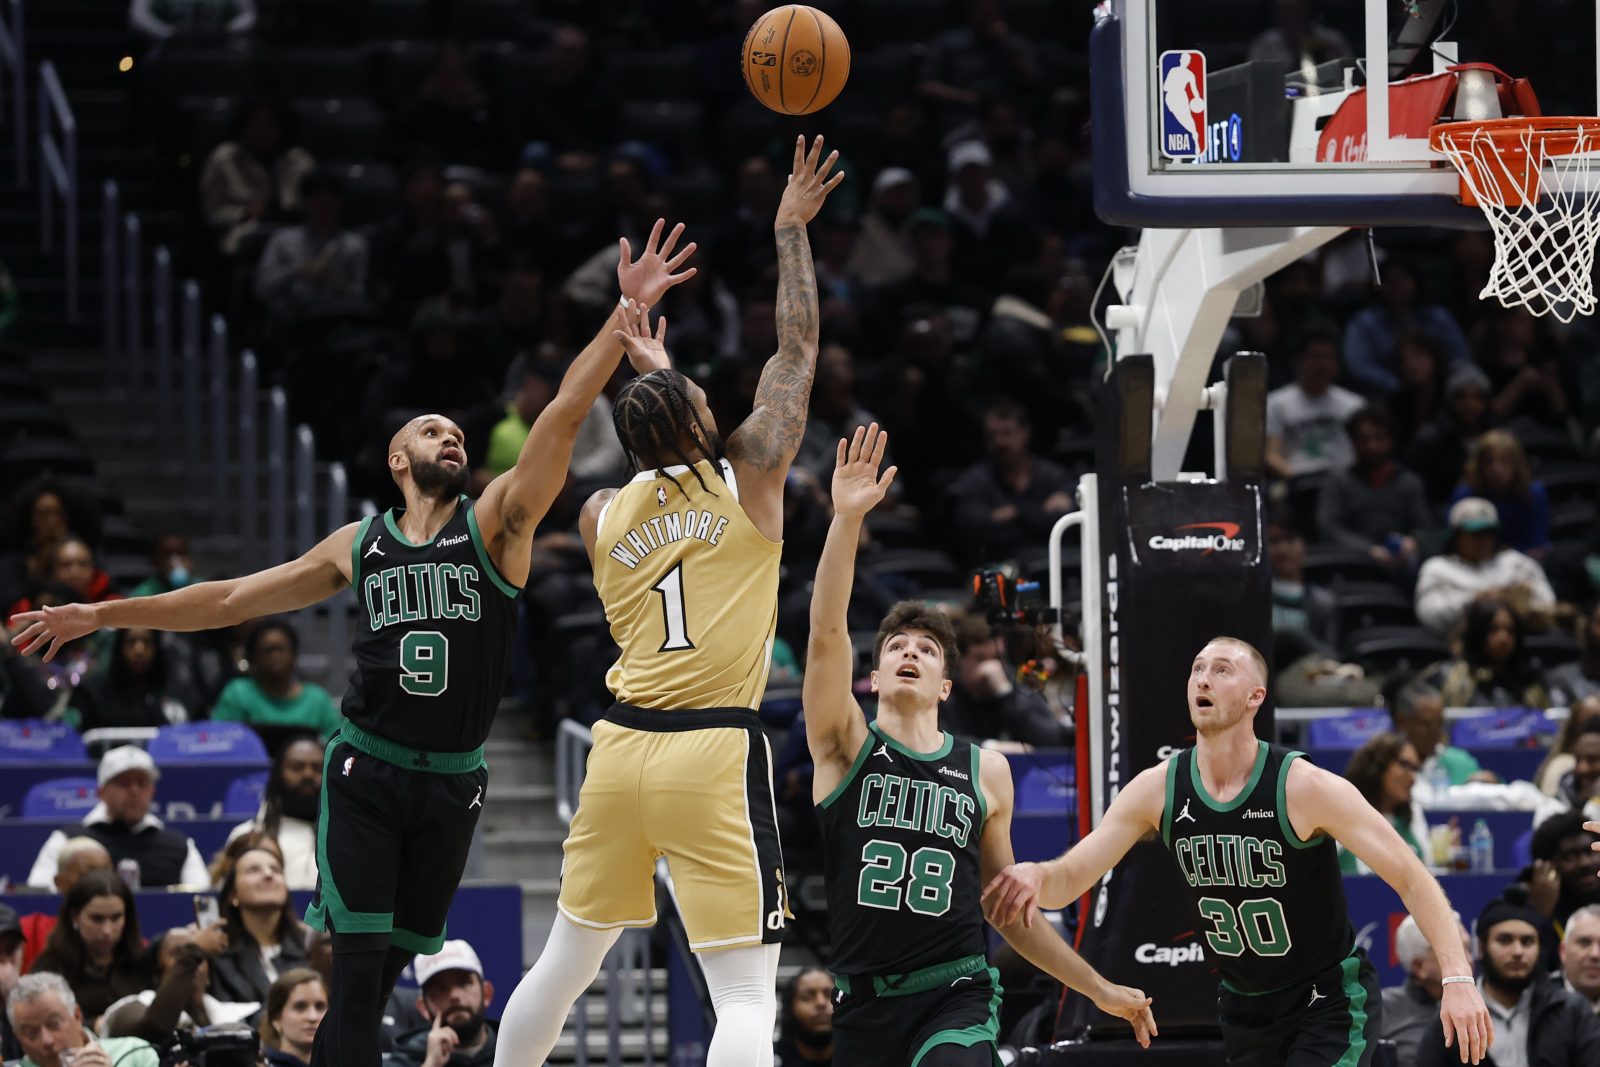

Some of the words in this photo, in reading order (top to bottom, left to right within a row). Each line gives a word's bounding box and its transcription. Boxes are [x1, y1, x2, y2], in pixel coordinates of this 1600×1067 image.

[1168, 134, 1190, 151] NBA
[436, 533, 469, 548] Amica
[609, 510, 729, 569] WHITMORE
[364, 563, 481, 631] CELTICS
[650, 559, 697, 653] 1
[399, 630, 449, 696] 9
[938, 766, 969, 781] Amica
[856, 773, 976, 848] CELTICS
[1242, 808, 1275, 819] Amica
[857, 839, 956, 917] 28
[1175, 834, 1286, 887] CELTICS
[1197, 897, 1292, 957] 30
